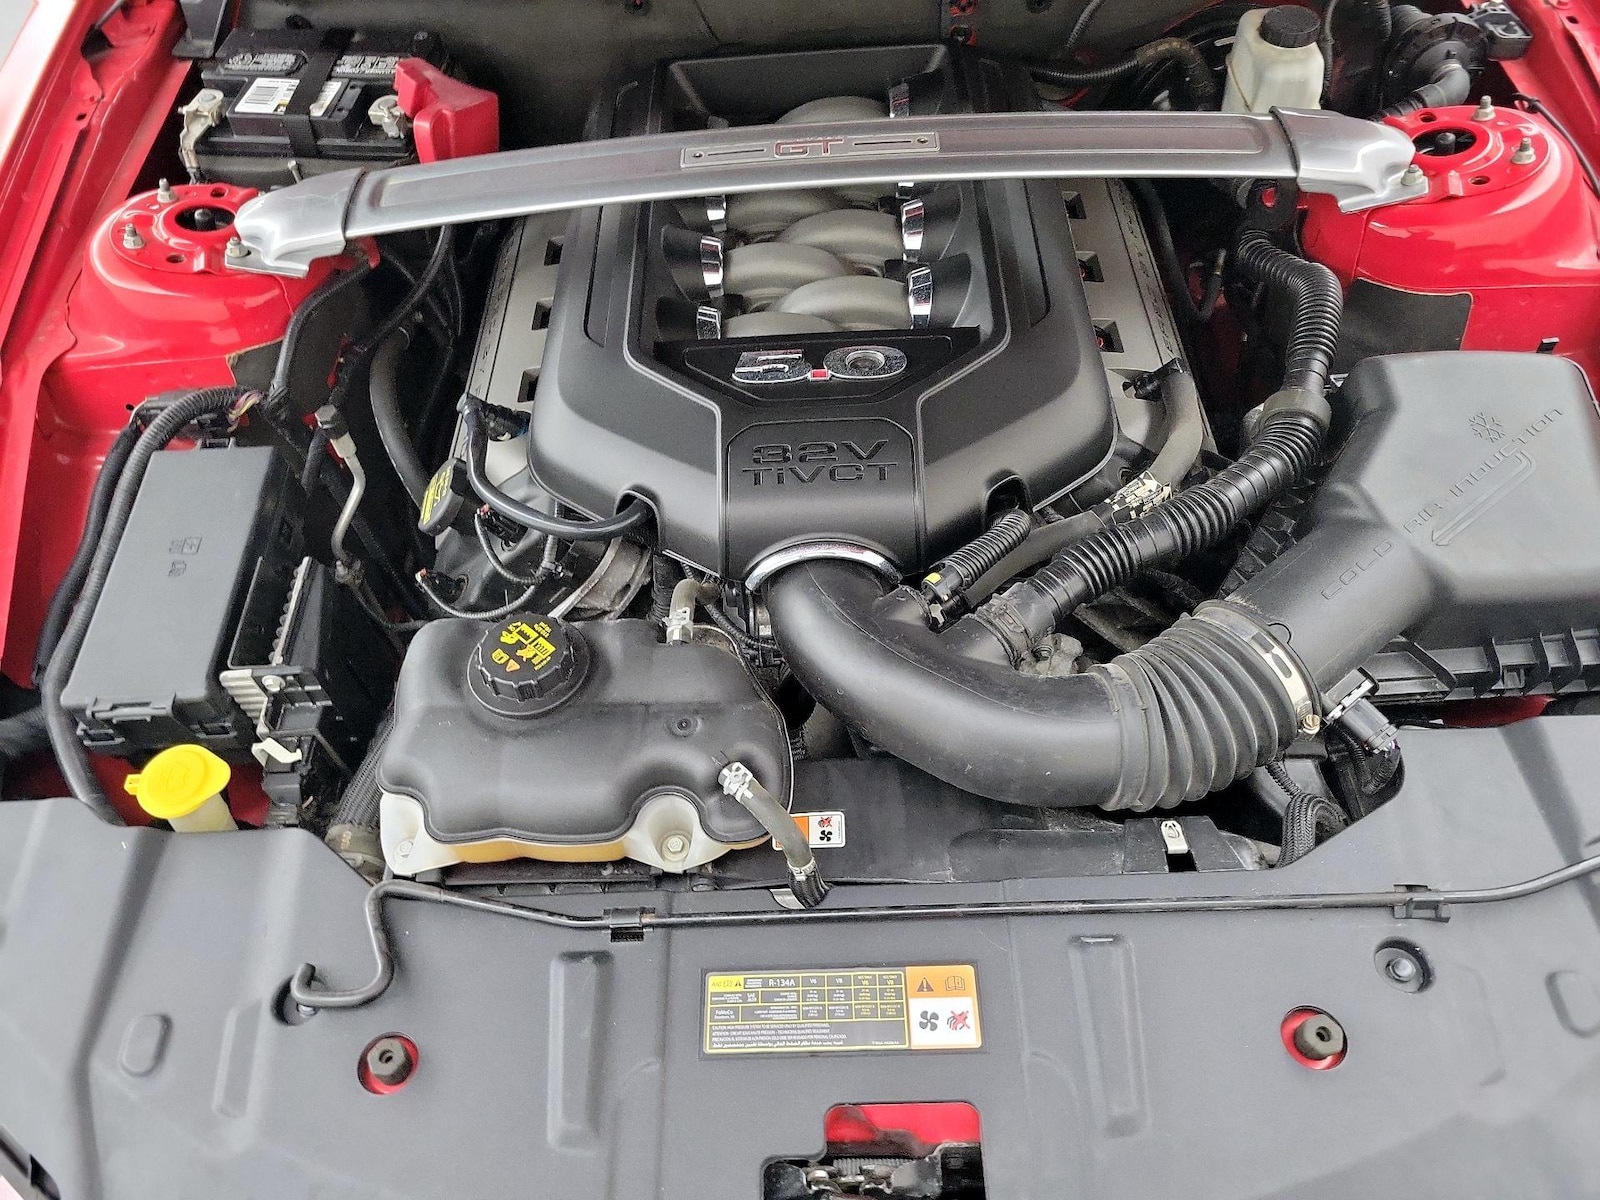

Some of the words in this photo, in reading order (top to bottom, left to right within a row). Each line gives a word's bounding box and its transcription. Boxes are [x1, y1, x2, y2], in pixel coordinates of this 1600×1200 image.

[774, 137, 844, 158] GT
[732, 345, 907, 383] 5.0
[752, 440, 889, 464] 32V
[1320, 538, 1392, 600] COLD
[1403, 502, 1443, 534] AIR
[768, 978, 796, 987] R-134A
